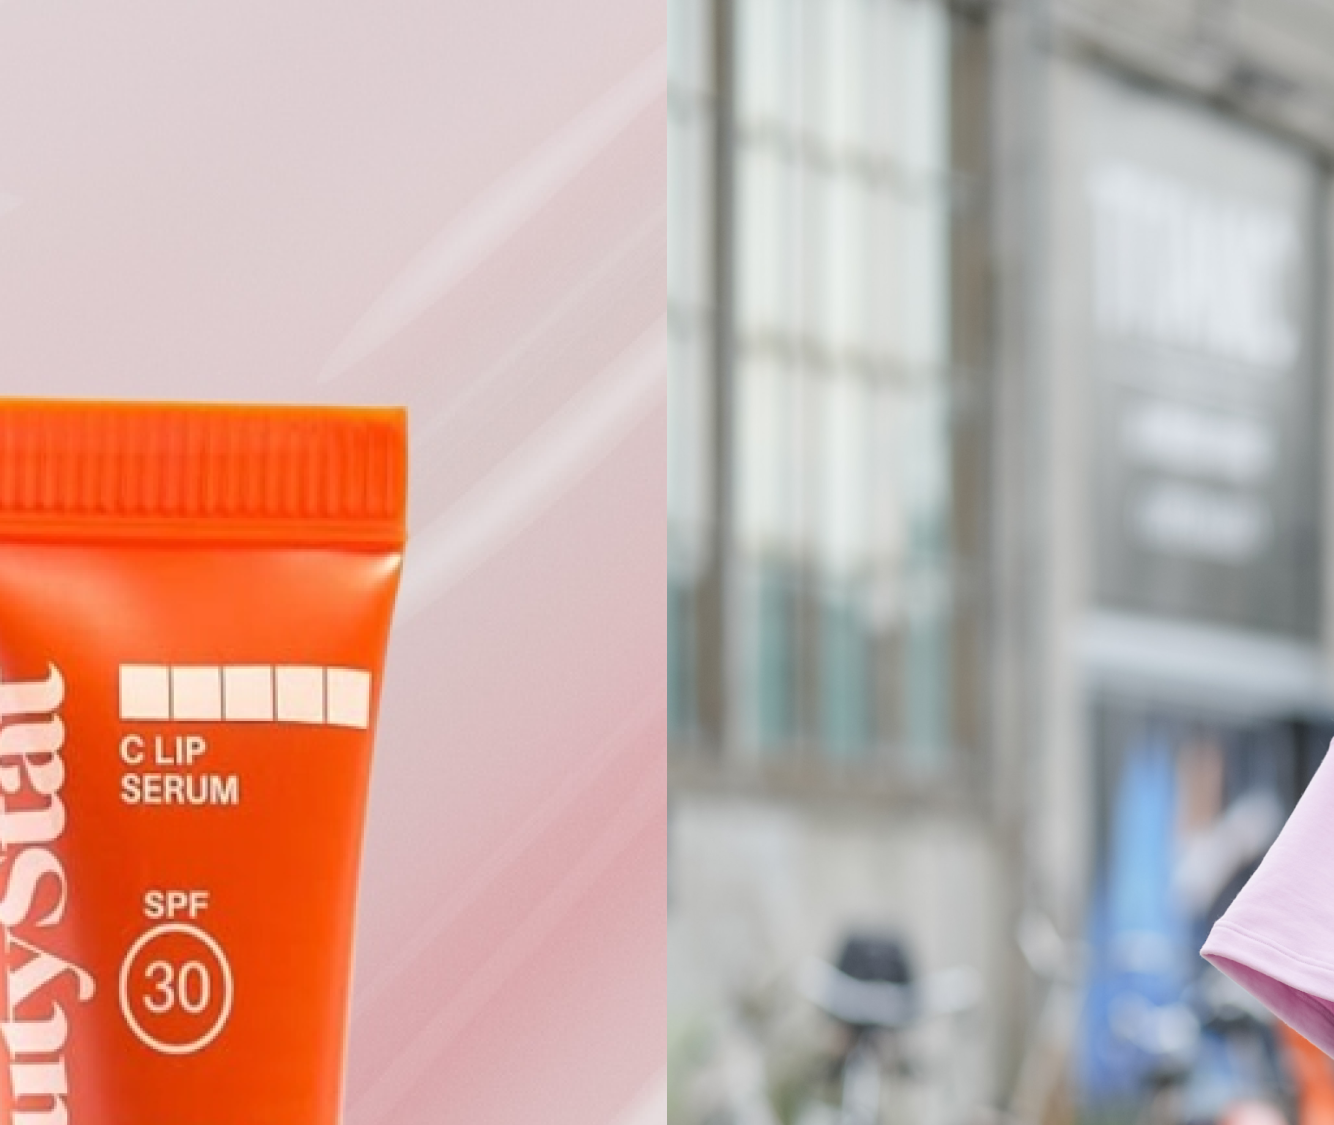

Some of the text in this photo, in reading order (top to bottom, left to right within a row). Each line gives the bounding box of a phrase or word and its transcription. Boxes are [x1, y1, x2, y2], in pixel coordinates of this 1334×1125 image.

[119, 735, 207, 766] C LIP
[120, 773, 240, 805] SERUM
[143, 891, 209, 919] SPF
[142, 961, 211, 1014] 30
